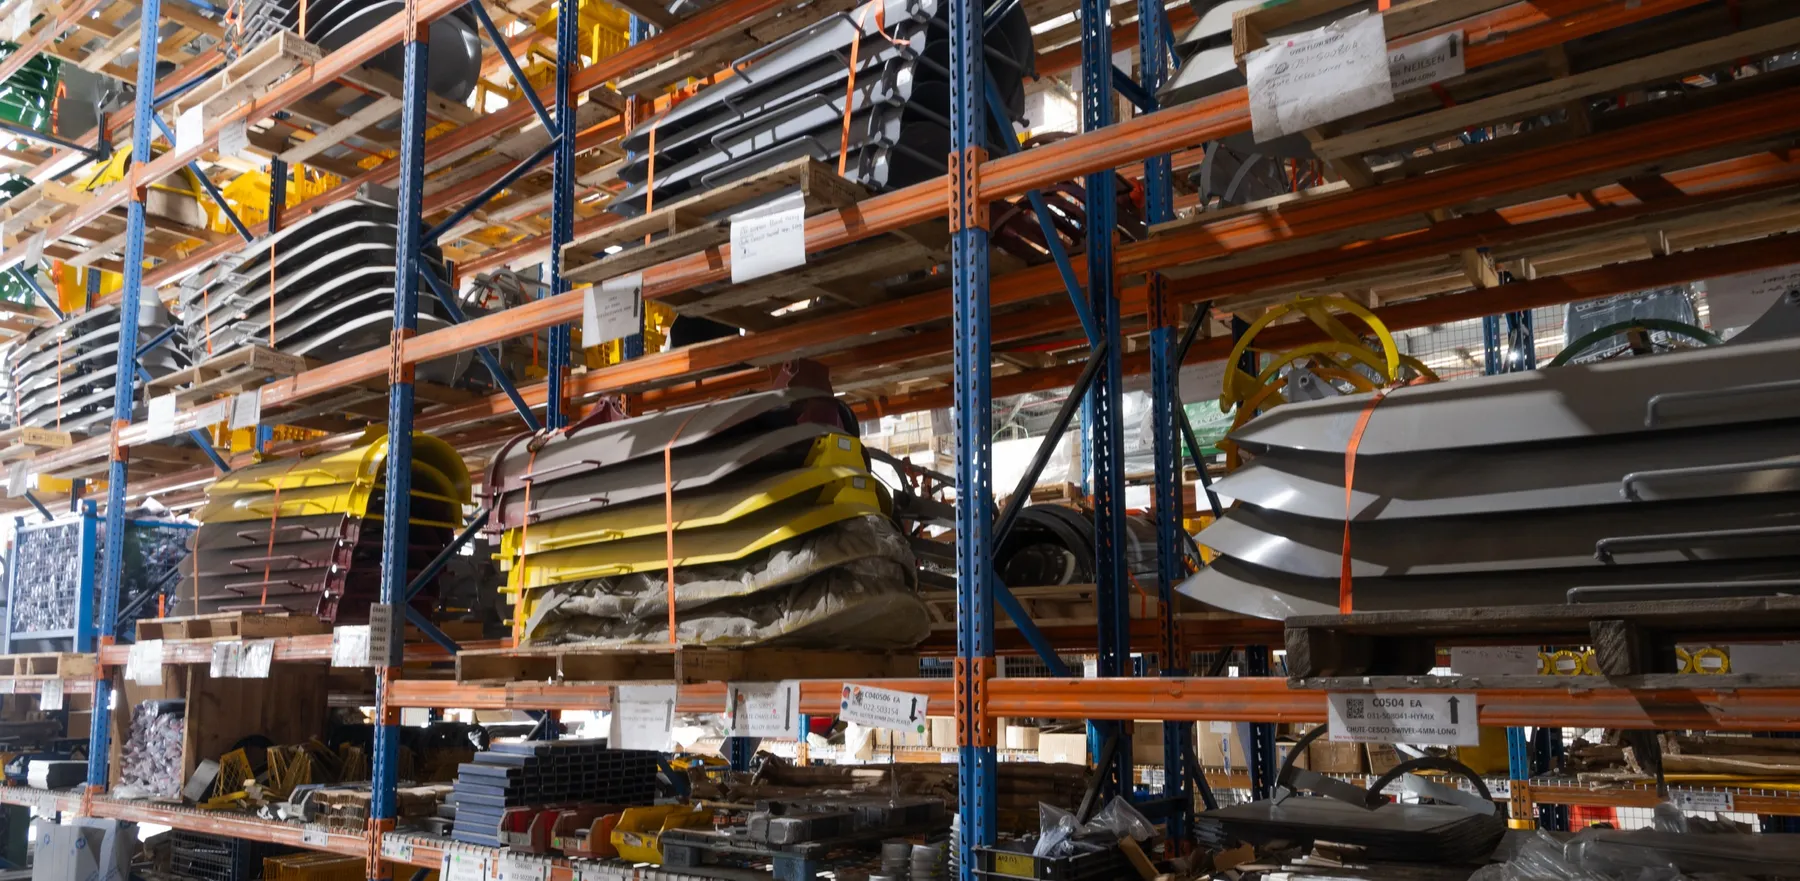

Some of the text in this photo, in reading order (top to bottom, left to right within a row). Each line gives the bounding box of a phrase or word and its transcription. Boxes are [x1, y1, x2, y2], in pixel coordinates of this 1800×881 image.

[1403, 54, 1445, 74] NEILSEN
[864, 691, 891, 702] C040506
[1372, 698, 1423, 708] C0504 EA
[863, 703, 899, 716] 022-503154
